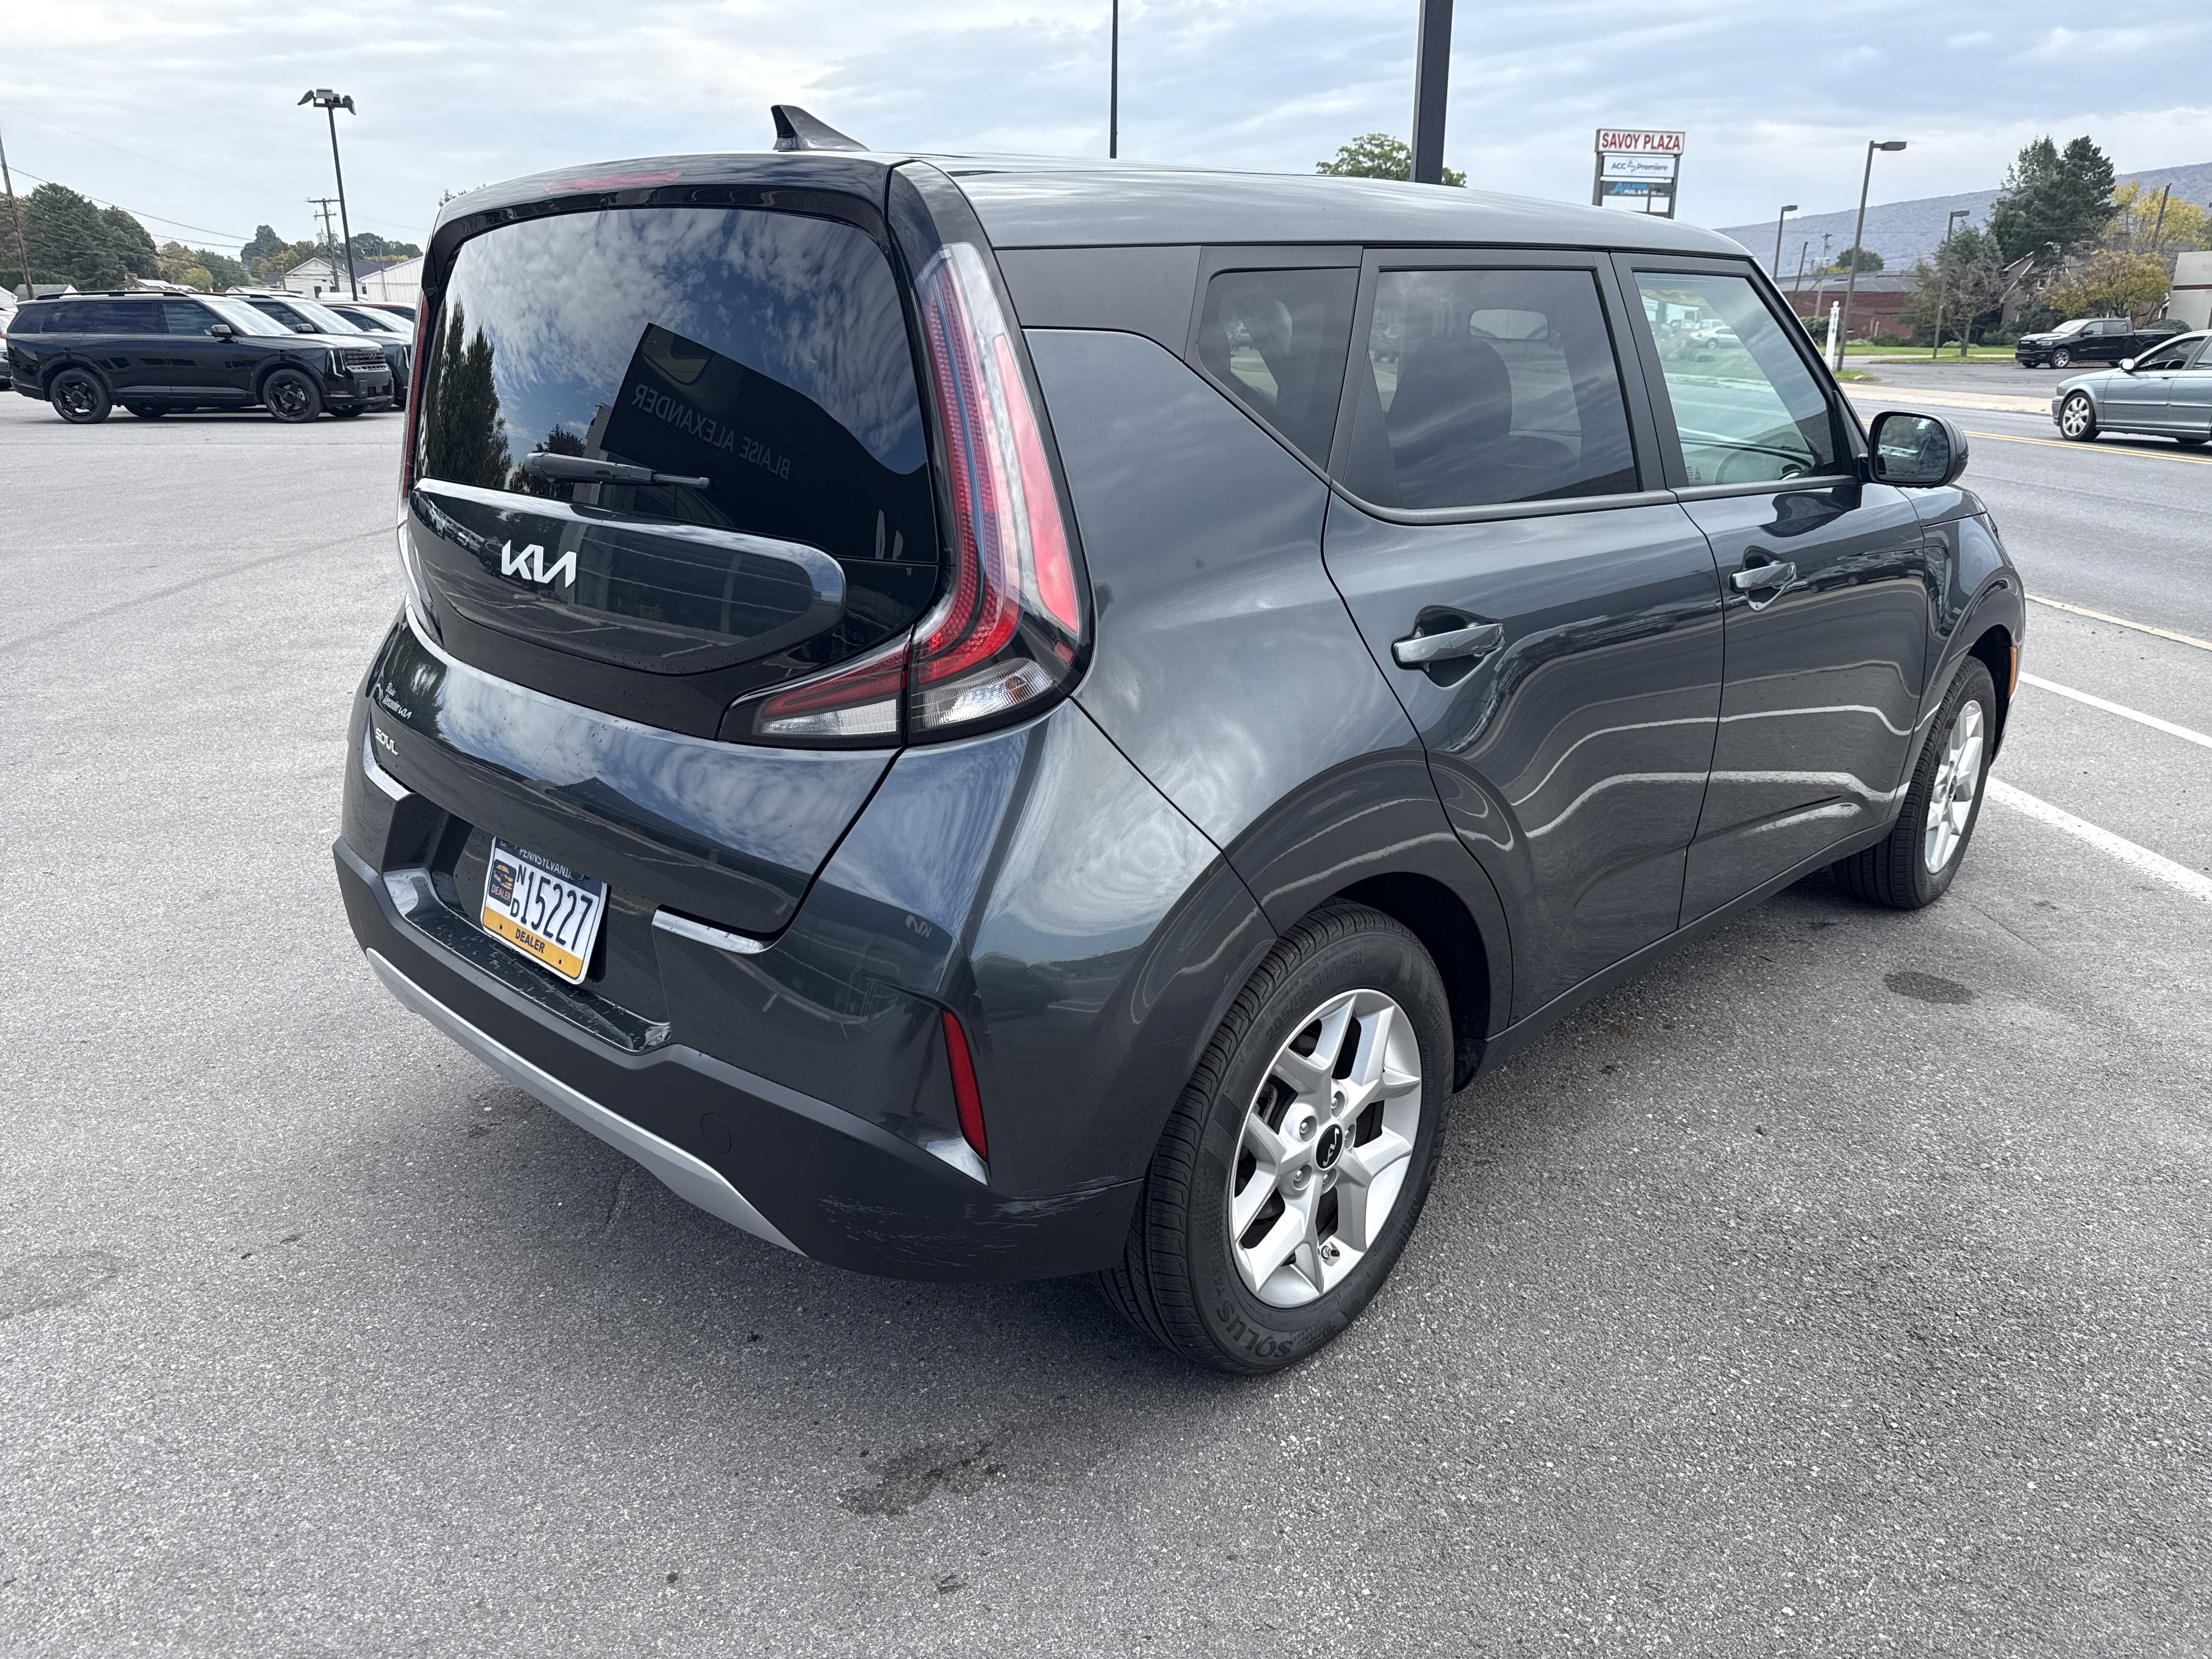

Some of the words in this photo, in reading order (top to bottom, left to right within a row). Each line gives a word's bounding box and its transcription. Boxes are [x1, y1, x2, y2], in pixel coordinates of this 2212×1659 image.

[1601, 133, 1641, 149] SAVOY
[1643, 134, 1680, 151] PLAZA
[501, 540, 577, 588] KIA
[375, 727, 400, 755] SOUL
[491, 884, 511, 902] DEALER
[515, 928, 545, 953] DEALER
[1216, 1299, 1294, 1358] SOLUS
